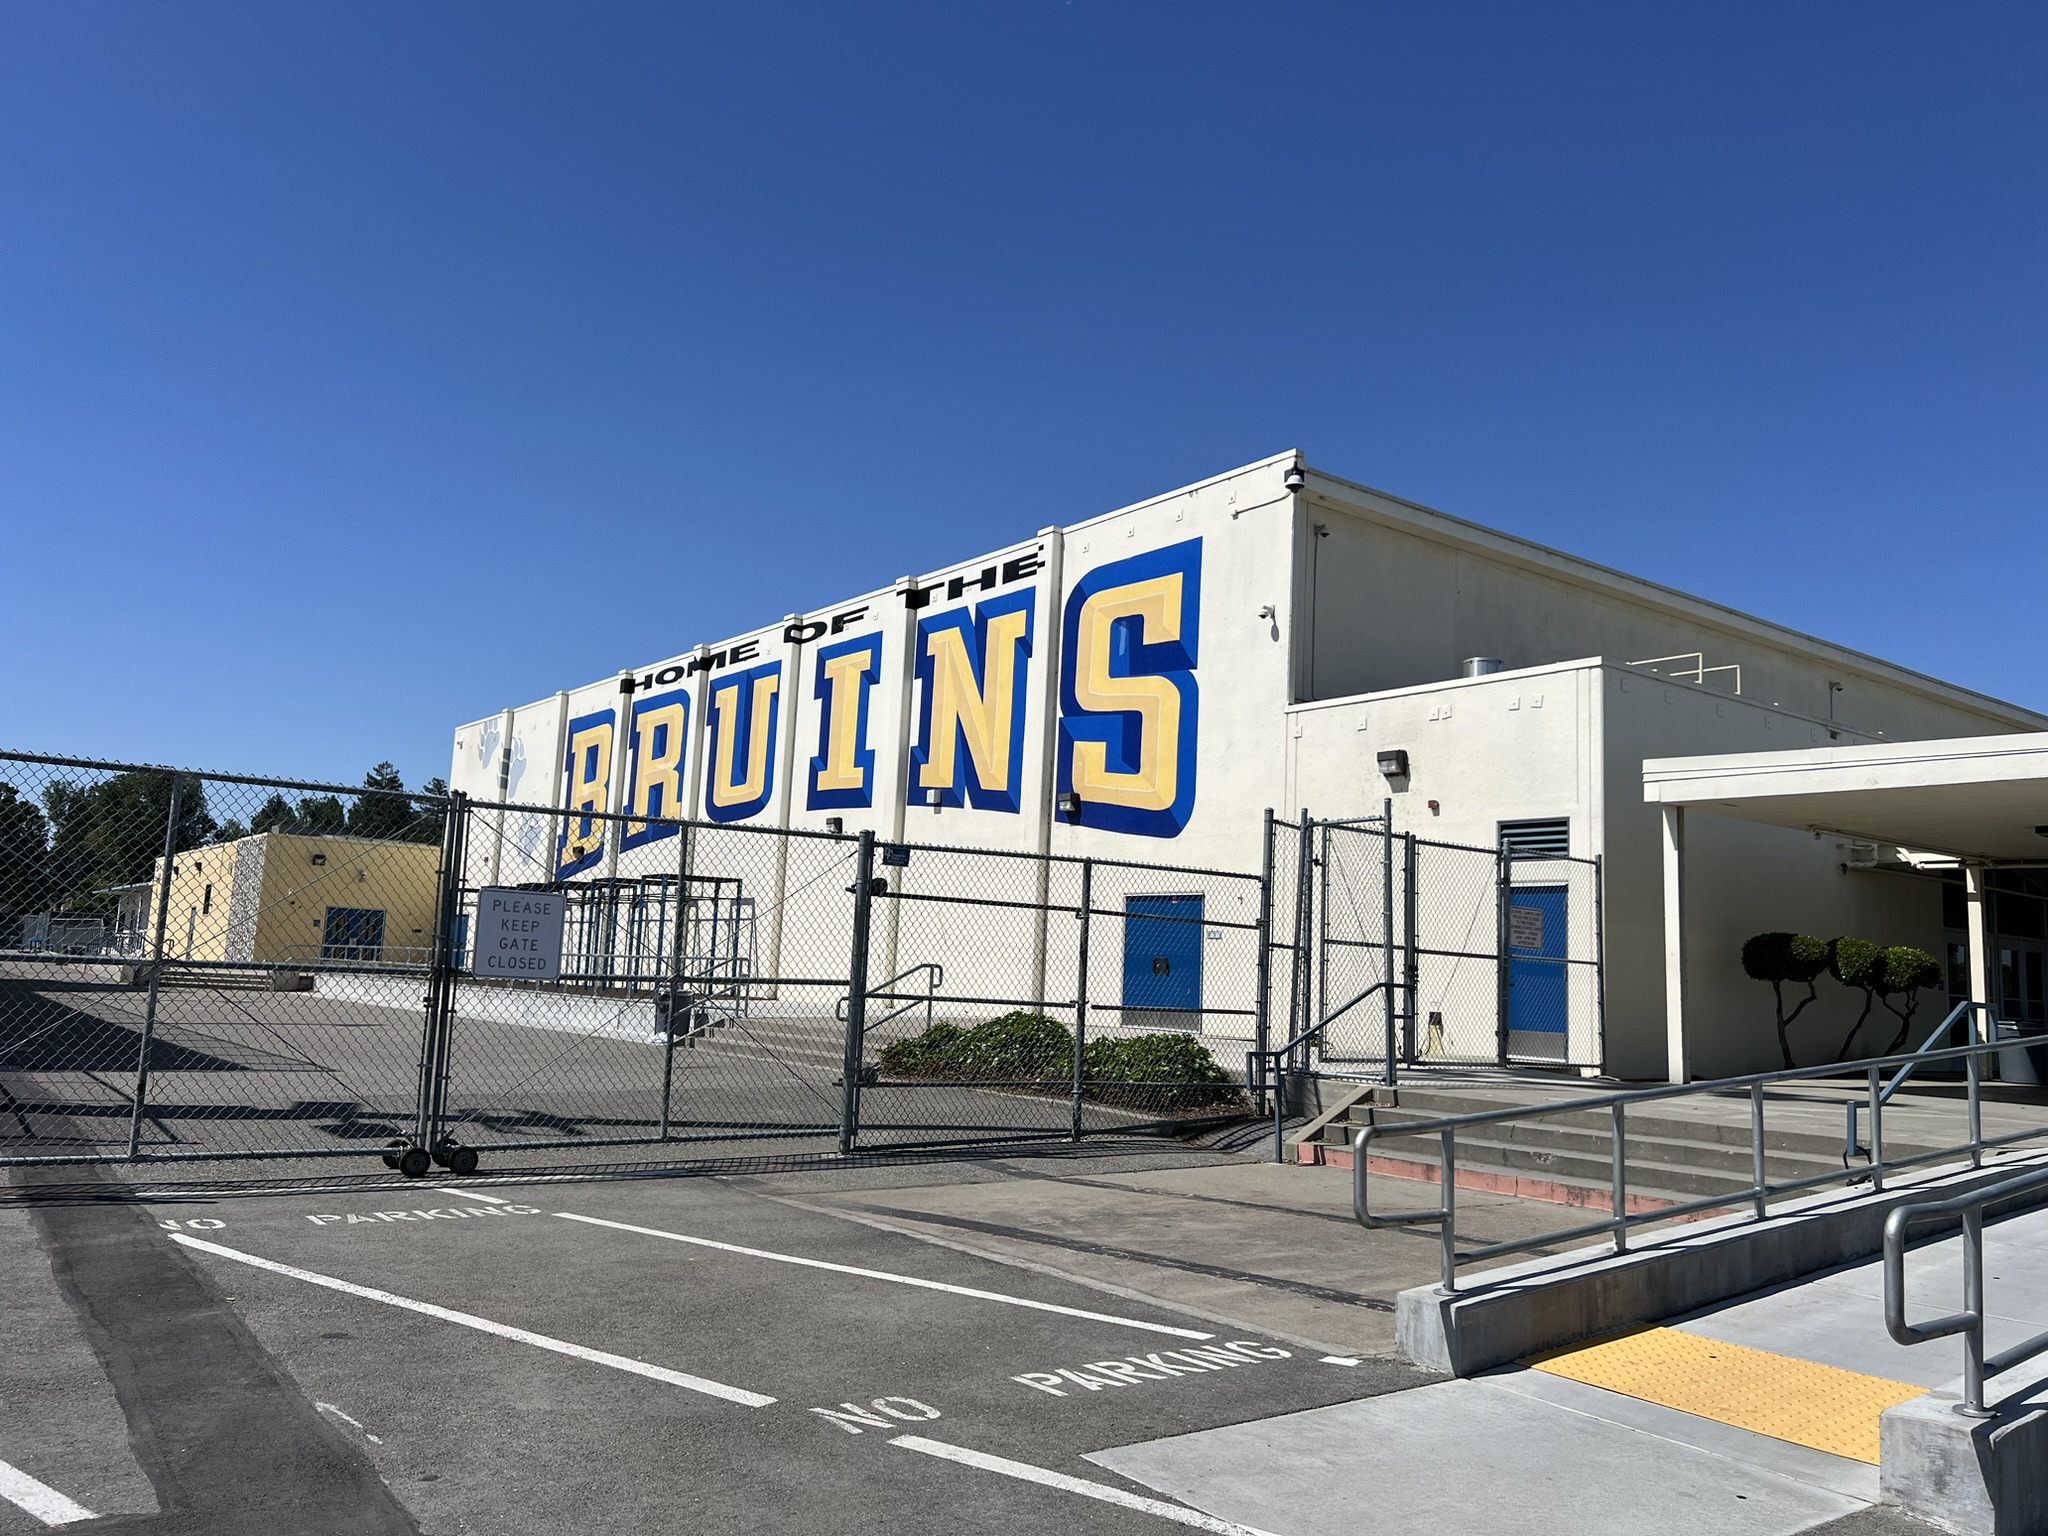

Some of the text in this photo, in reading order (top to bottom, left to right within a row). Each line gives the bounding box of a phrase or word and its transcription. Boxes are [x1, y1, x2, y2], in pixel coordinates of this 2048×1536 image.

[620, 544, 1046, 694] HOME OF THE
[556, 536, 1204, 881] BRUINS
[493, 899, 551, 915] PLEASE
[501, 918, 540, 932] KEEP
[499, 937, 539, 951] GATE
[488, 955, 547, 970] CLOSED
[305, 1204, 542, 1226] PARKING
[808, 1340, 1293, 1435] NO PARKING
